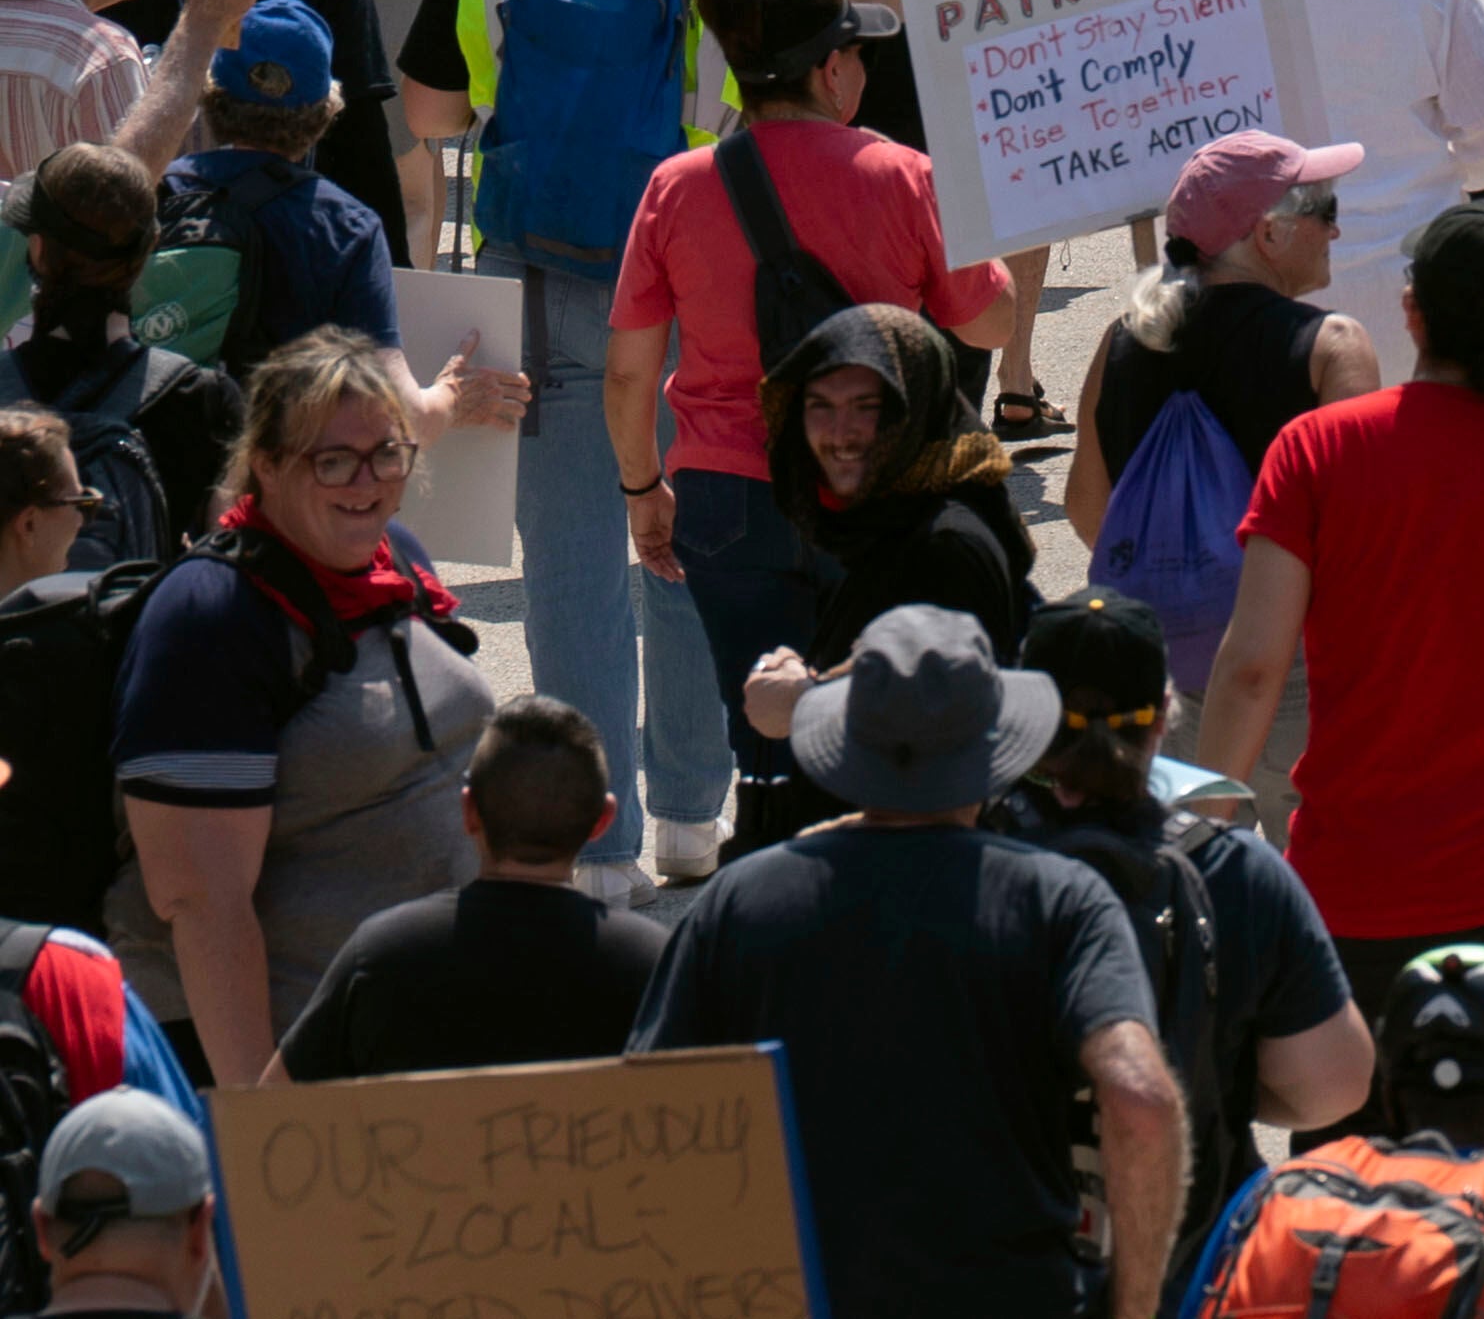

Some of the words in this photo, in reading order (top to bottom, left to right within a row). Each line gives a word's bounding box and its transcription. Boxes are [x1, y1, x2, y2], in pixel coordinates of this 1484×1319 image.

[982, 28, 1067, 80] Don't
[1075, 10, 1147, 53] Stay
[990, 66, 1066, 120] Don't
[1080, 33, 1195, 93] Comply
[995, 124, 1067, 158] Rise
[1081, 71, 1240, 132] Together
[1040, 141, 1130, 186] TAKE
[1147, 94, 1264, 158] ACTION
[262, 1118, 465, 1206] OUR
[405, 1195, 643, 1266] LOCAL
